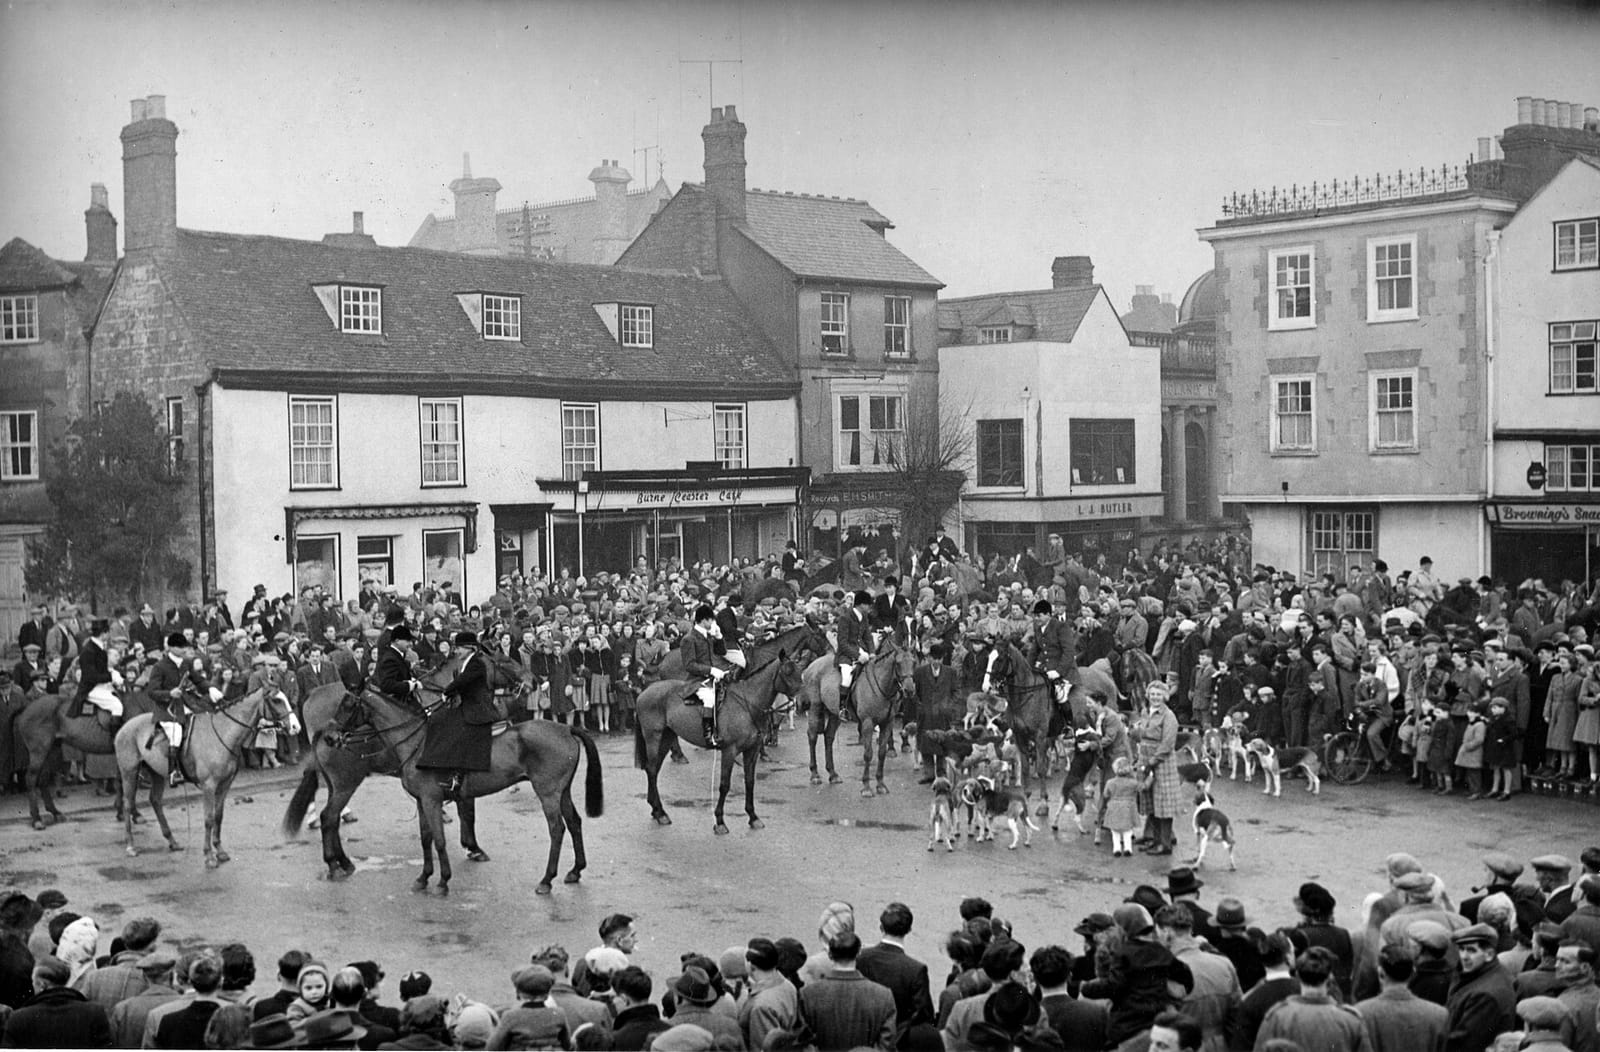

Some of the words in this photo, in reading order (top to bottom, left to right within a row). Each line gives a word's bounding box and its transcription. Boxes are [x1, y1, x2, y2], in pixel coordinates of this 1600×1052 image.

[637, 491, 667, 504] Burne
[1100, 502, 1132, 514] BUTLER
[1502, 506, 1570, 523] Browning's
